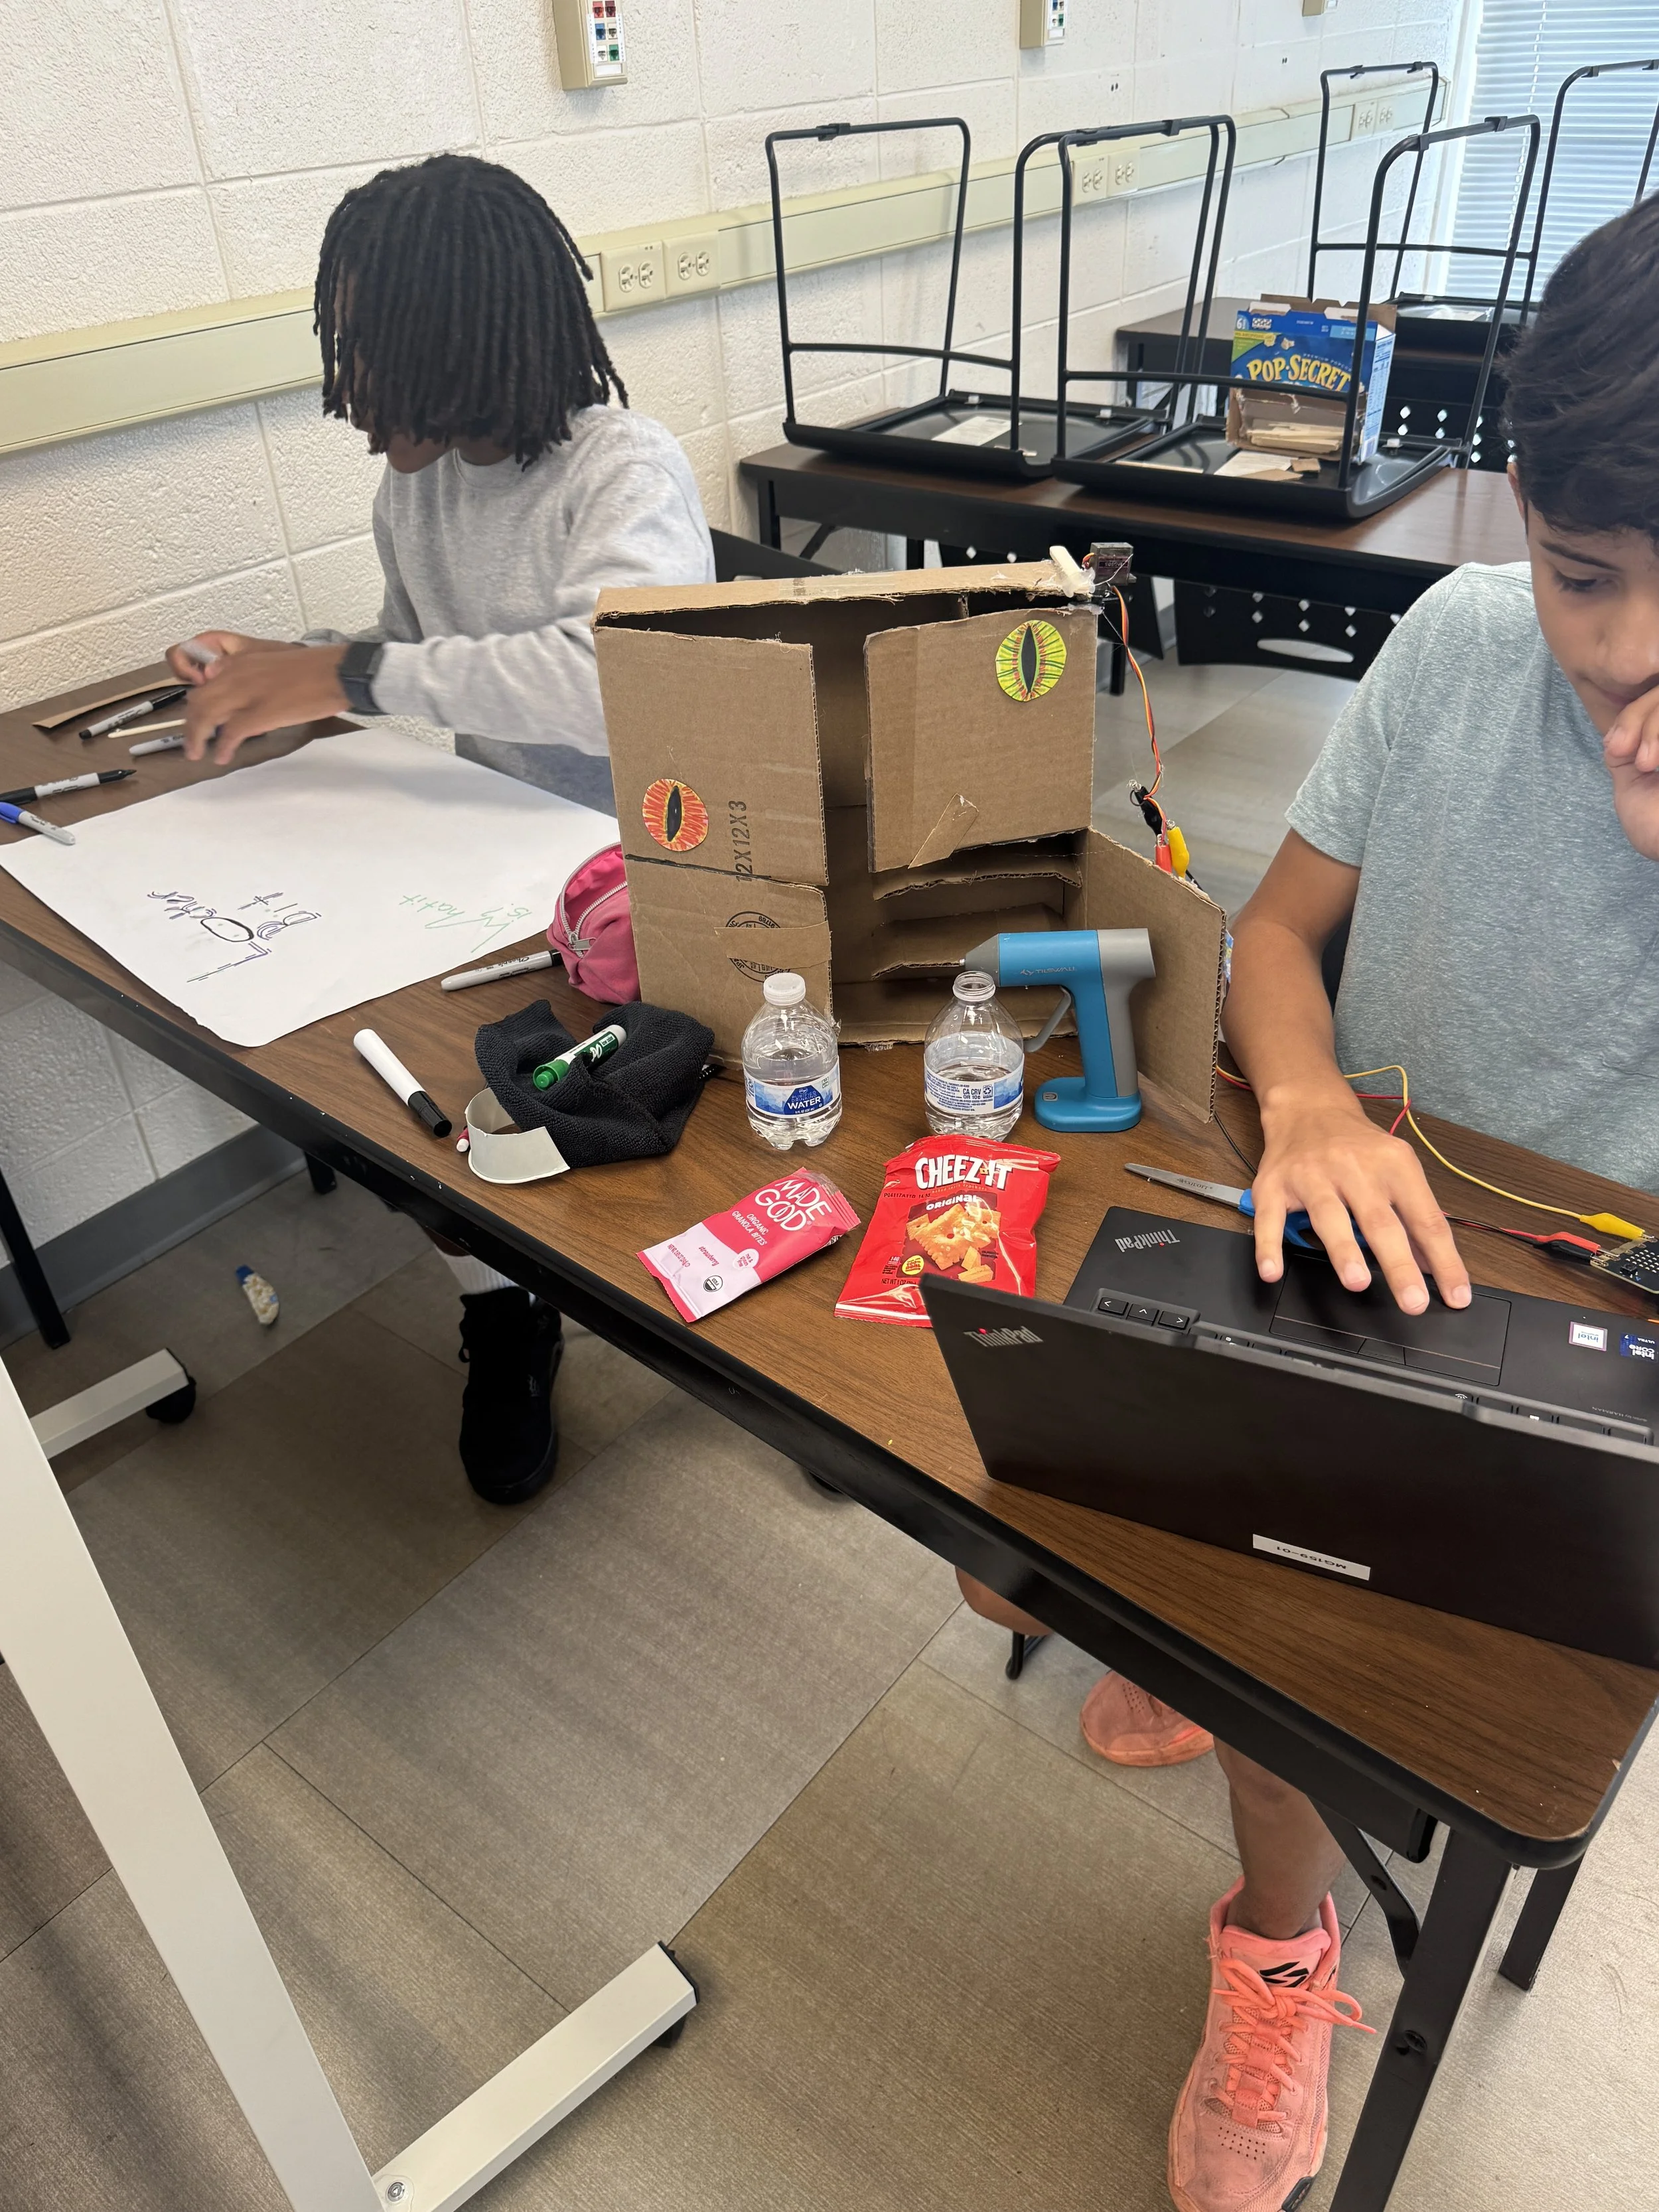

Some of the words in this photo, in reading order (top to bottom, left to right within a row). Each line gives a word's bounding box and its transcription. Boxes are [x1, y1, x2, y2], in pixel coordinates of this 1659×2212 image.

[787, 1096, 821, 1110] WATER
[755, 1188, 806, 1231] GOOD
[775, 1179, 833, 1221] MADE
[732, 1210, 753, 1236] GRANOLA
[751, 1230, 767, 1246] BITES
[746, 1213, 769, 1236] ORGANIC
[1114, 1228, 1181, 1253] ThinkPad
[963, 1325, 1044, 1348] ThinkPad
[1577, 1333, 1599, 1343] intel
